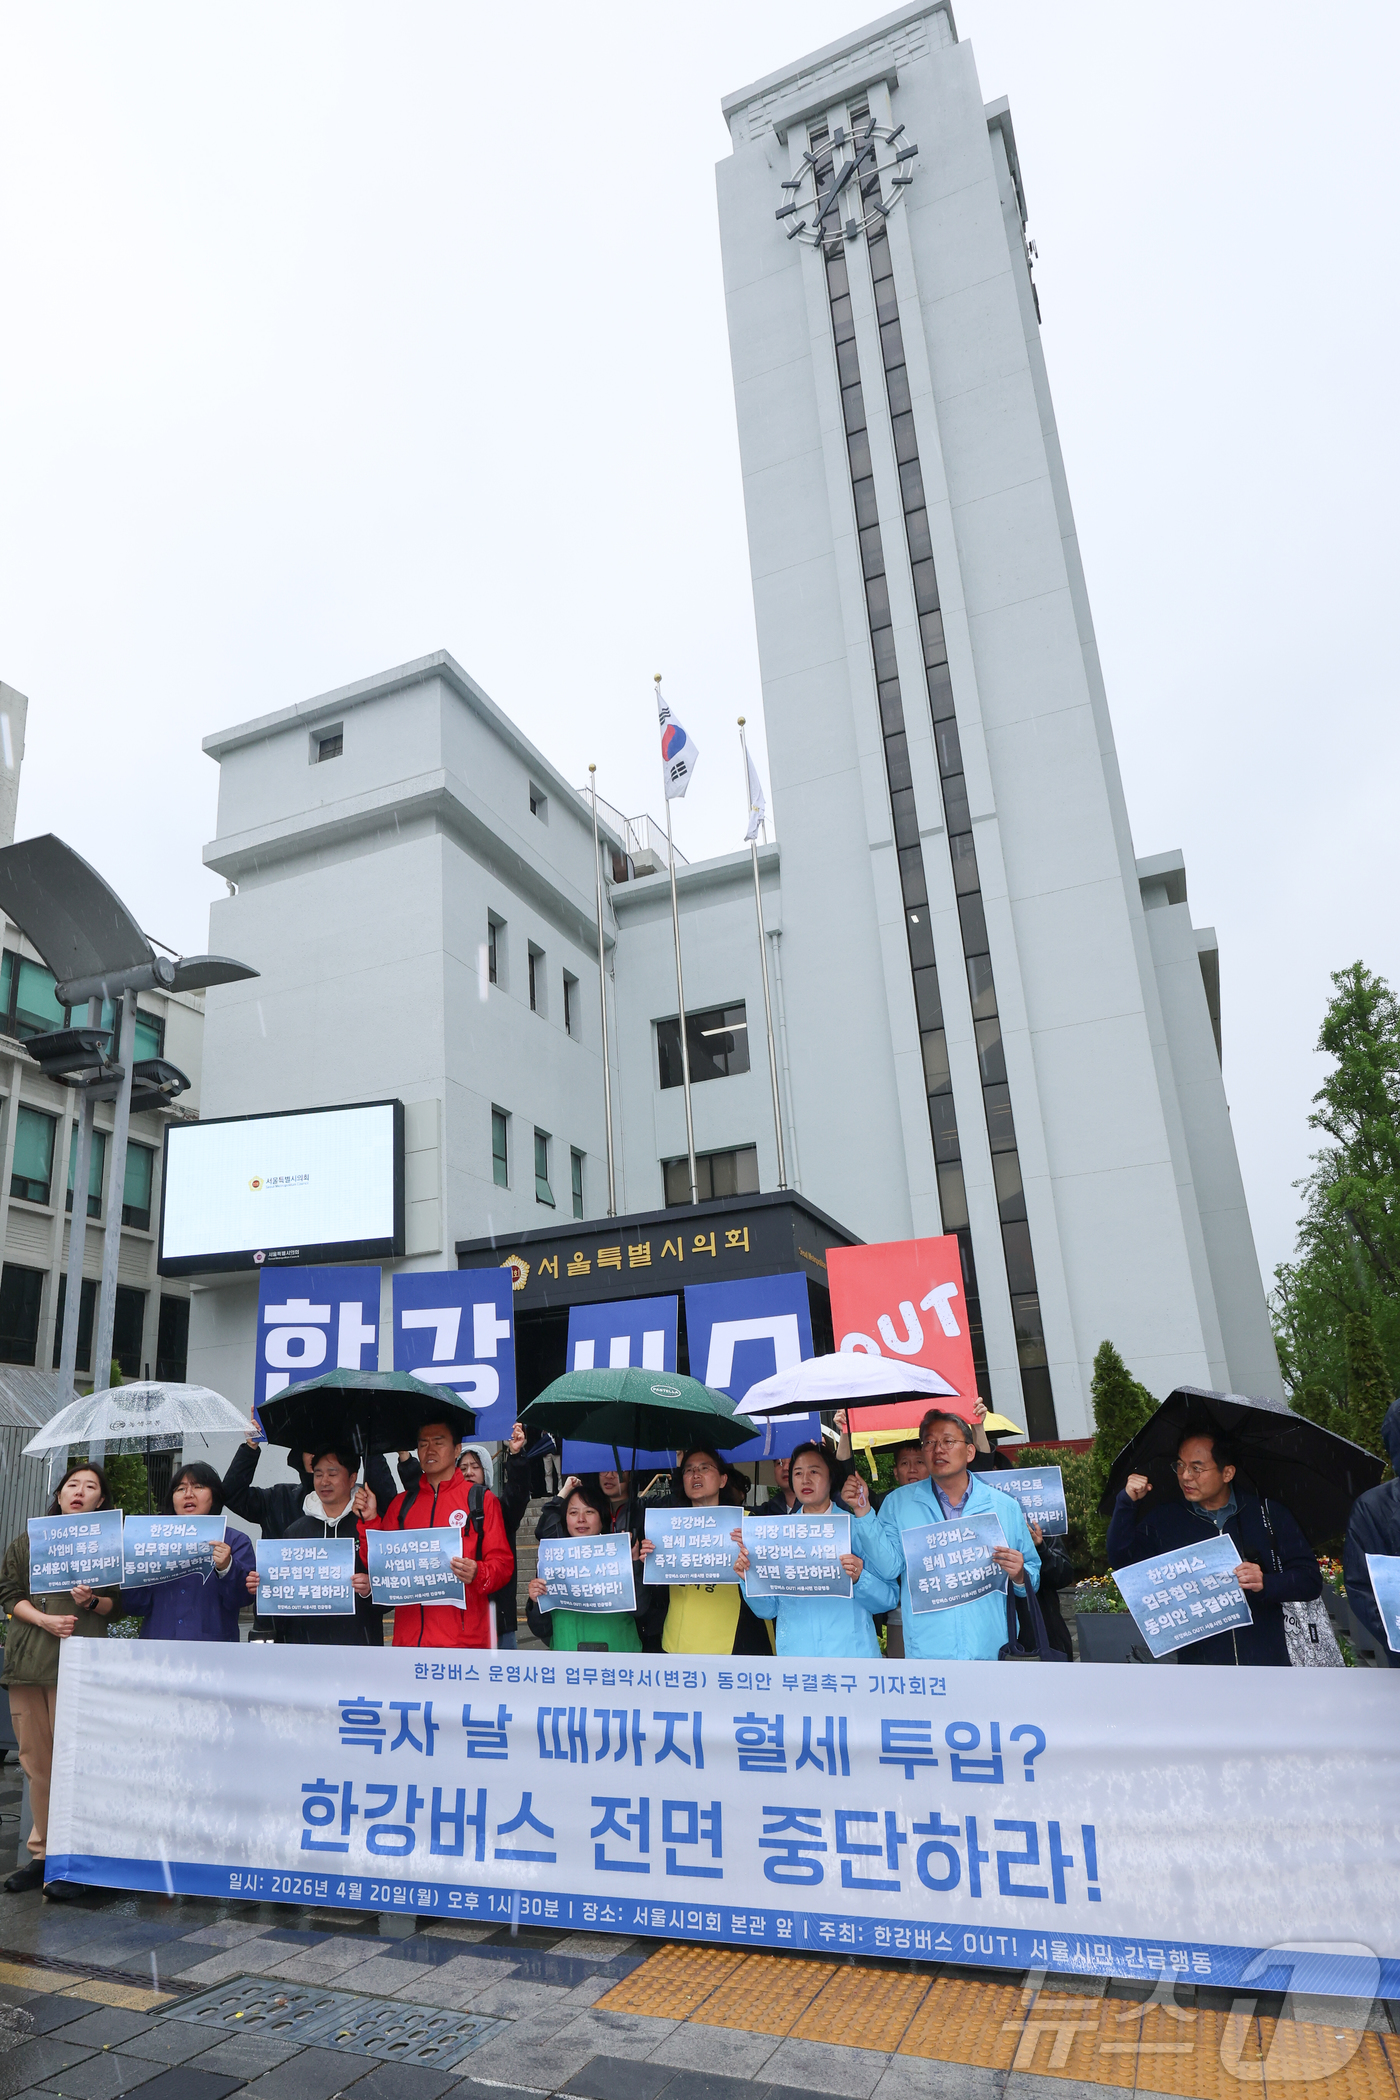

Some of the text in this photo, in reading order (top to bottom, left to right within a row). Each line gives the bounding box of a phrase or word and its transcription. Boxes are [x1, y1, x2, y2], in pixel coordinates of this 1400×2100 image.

[537, 1226, 750, 1279] 서울특별시의회
[988, 1478, 1044, 1492] 64억으로
[1022, 1494, 1043, 1508] 폭증
[150, 1524, 198, 1538] 한강버스
[670, 1516, 716, 1530] 한강버스
[42, 1524, 102, 1540] 1,964억으로
[754, 1524, 835, 1539] 위장 대중교통
[926, 1528, 976, 1549] 한강버스
[48, 1540, 99, 1556] 사업비 폭증
[134, 1542, 210, 1556] 업무협약 변경
[378, 1540, 441, 1556] 1,964억으로
[662, 1534, 724, 1548] 혈세 퍼붓기
[281, 1546, 328, 1561] 한강버스
[544, 1542, 618, 1561] 위장 대중교통
[754, 1544, 836, 1560] 한강버스 사업
[922, 1545, 991, 1572] 혈세 퍼붓기
[32, 1556, 120, 1576] 오세훈이 책임져라!
[124, 1561, 162, 1575] 동의안
[385, 1557, 441, 1572] 사업비 폭증
[654, 1553, 731, 1568] 즉각 중단하라!
[268, 1566, 342, 1580] 업무협약 변경
[544, 1562, 620, 1580] 한강버스 사업
[756, 1565, 840, 1580] 전면 중단하라!
[918, 1562, 1002, 1594] 즉각 중단하라!
[1146, 1556, 1206, 1586] 한강버스
[372, 1576, 411, 1588] 오세훈이
[546, 1581, 623, 1598] 전면 중단하라!
[261, 1585, 350, 1599] 동의안 부결하라!
[1142, 1570, 1233, 1611] 업무협약 변경
[1144, 1608, 1190, 1636] 동의안
[414, 1662, 947, 1696] 한강버스 운영사업 업무협약서(변경) 동의안 부결촉구 기자회견
[338, 1696, 1046, 1784] 흑자 날 때까지 혈세 투입?
[300, 1778, 1102, 1904] 한강버스 전면 중단하라!
[229, 1872, 264, 1892] 일시:
[272, 1876, 328, 1898] 2026년
[336, 1882, 362, 1901] 4월
[370, 1884, 438, 1907] 20일(월)
[448, 1892, 480, 1910] 오후
[488, 1895, 512, 1914] 1시
[520, 1897, 560, 1918] 30분
[582, 1902, 623, 1922] 장소:
[633, 1906, 722, 1932] 서울시의회
[730, 1914, 766, 1936] 본관
[776, 1918, 794, 1938] 앞
[819, 1921, 863, 1944] 주최:
[874, 1925, 952, 1951] 한강버스
[963, 1932, 1017, 1956] OUT!
[1030, 1938, 1112, 1966] 서울시민
[1124, 1946, 1212, 1974] 긴급행동
